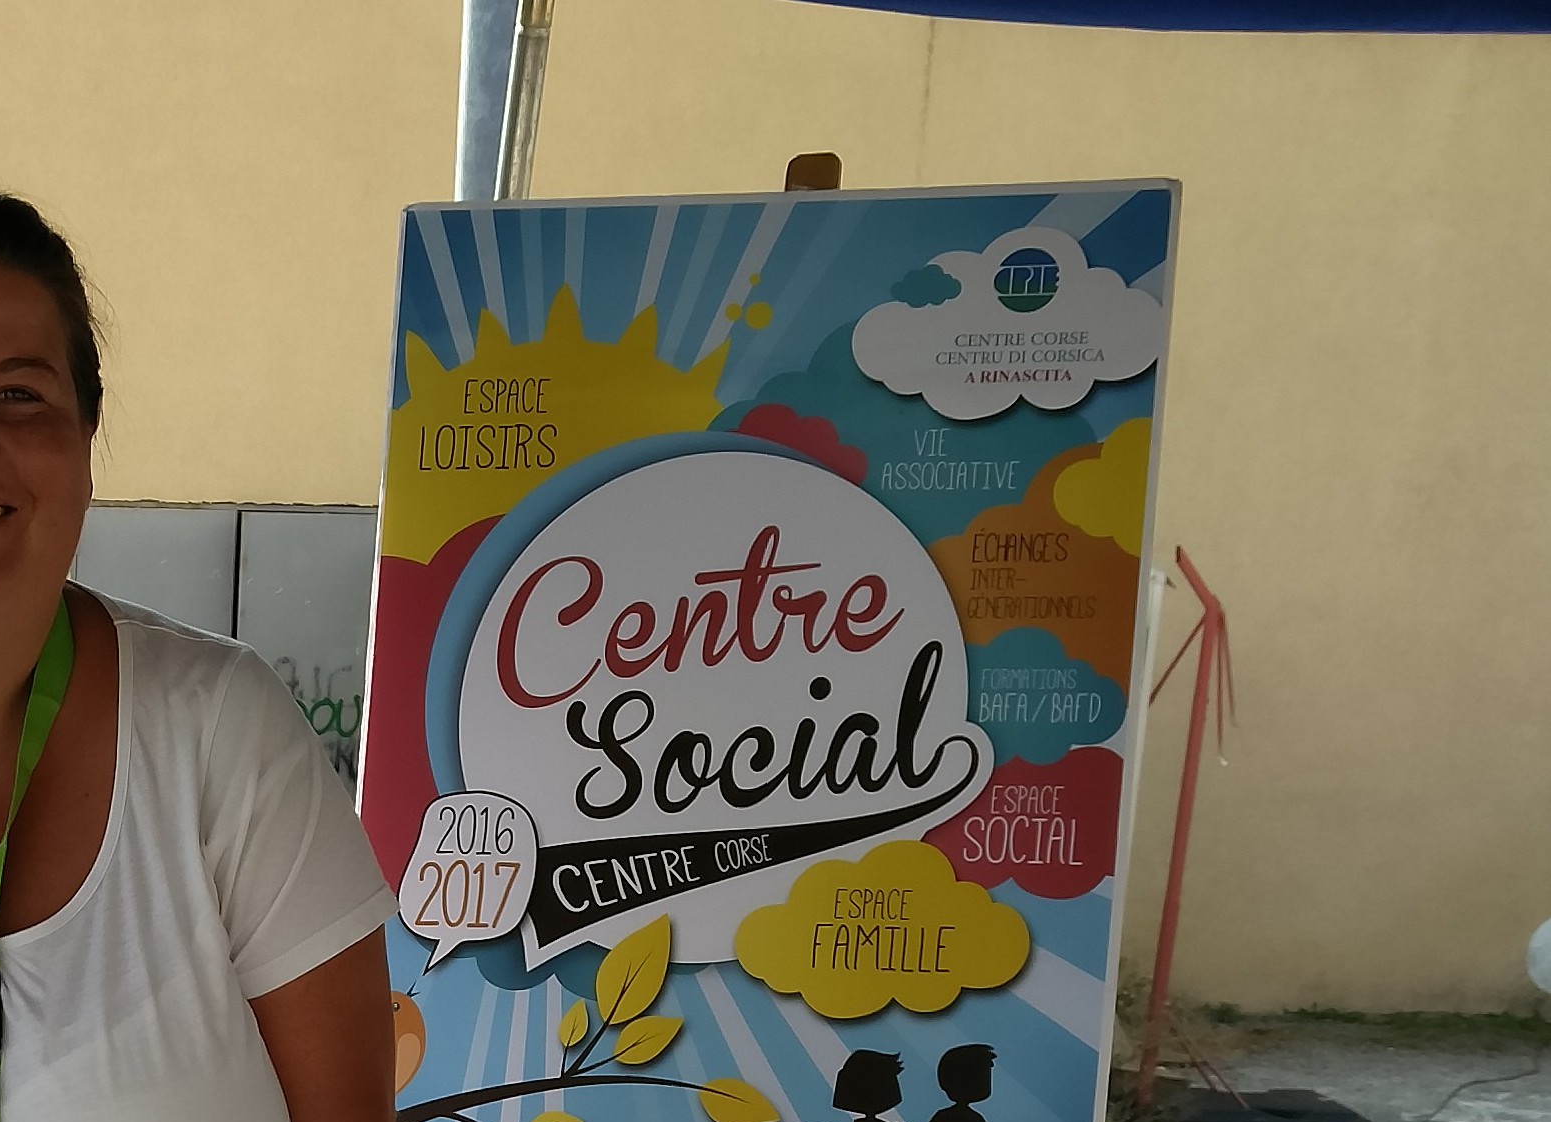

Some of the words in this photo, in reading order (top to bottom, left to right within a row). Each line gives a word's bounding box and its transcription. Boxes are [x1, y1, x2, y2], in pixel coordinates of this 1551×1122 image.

[954, 332, 1025, 347] CENTRE
[1031, 331, 1089, 345] CORSE
[936, 350, 1003, 365] CENTRU
[1008, 350, 1026, 363] DI
[1031, 348, 1105, 362] CORSICA
[965, 370, 976, 383] A
[980, 369, 1072, 383] RINASCITA
[463, 378, 551, 415] ESPACE
[419, 424, 558, 470] LOISIRS
[914, 429, 950, 457] VIE
[881, 460, 1021, 491] ASSOCIATIVE
[972, 528, 1069, 562] ÉCHANGES
[970, 567, 1026, 591] INTER-
[496, 525, 905, 708] Centre
[981, 668, 1077, 690] FORMATIONS
[979, 692, 1029, 723] BAFA
[1050, 692, 1101, 723] BAFD
[565, 640, 979, 820] Social
[991, 785, 1065, 815] ESPACE
[435, 805, 515, 856] 2016
[962, 815, 1083, 865] SOCIAL
[552, 845, 700, 913] CENTRE
[714, 834, 773, 872] CORSE
[415, 861, 521, 929] 2017
[834, 889, 913, 921] ESPACE
[812, 923, 956, 973] FAMILLE
